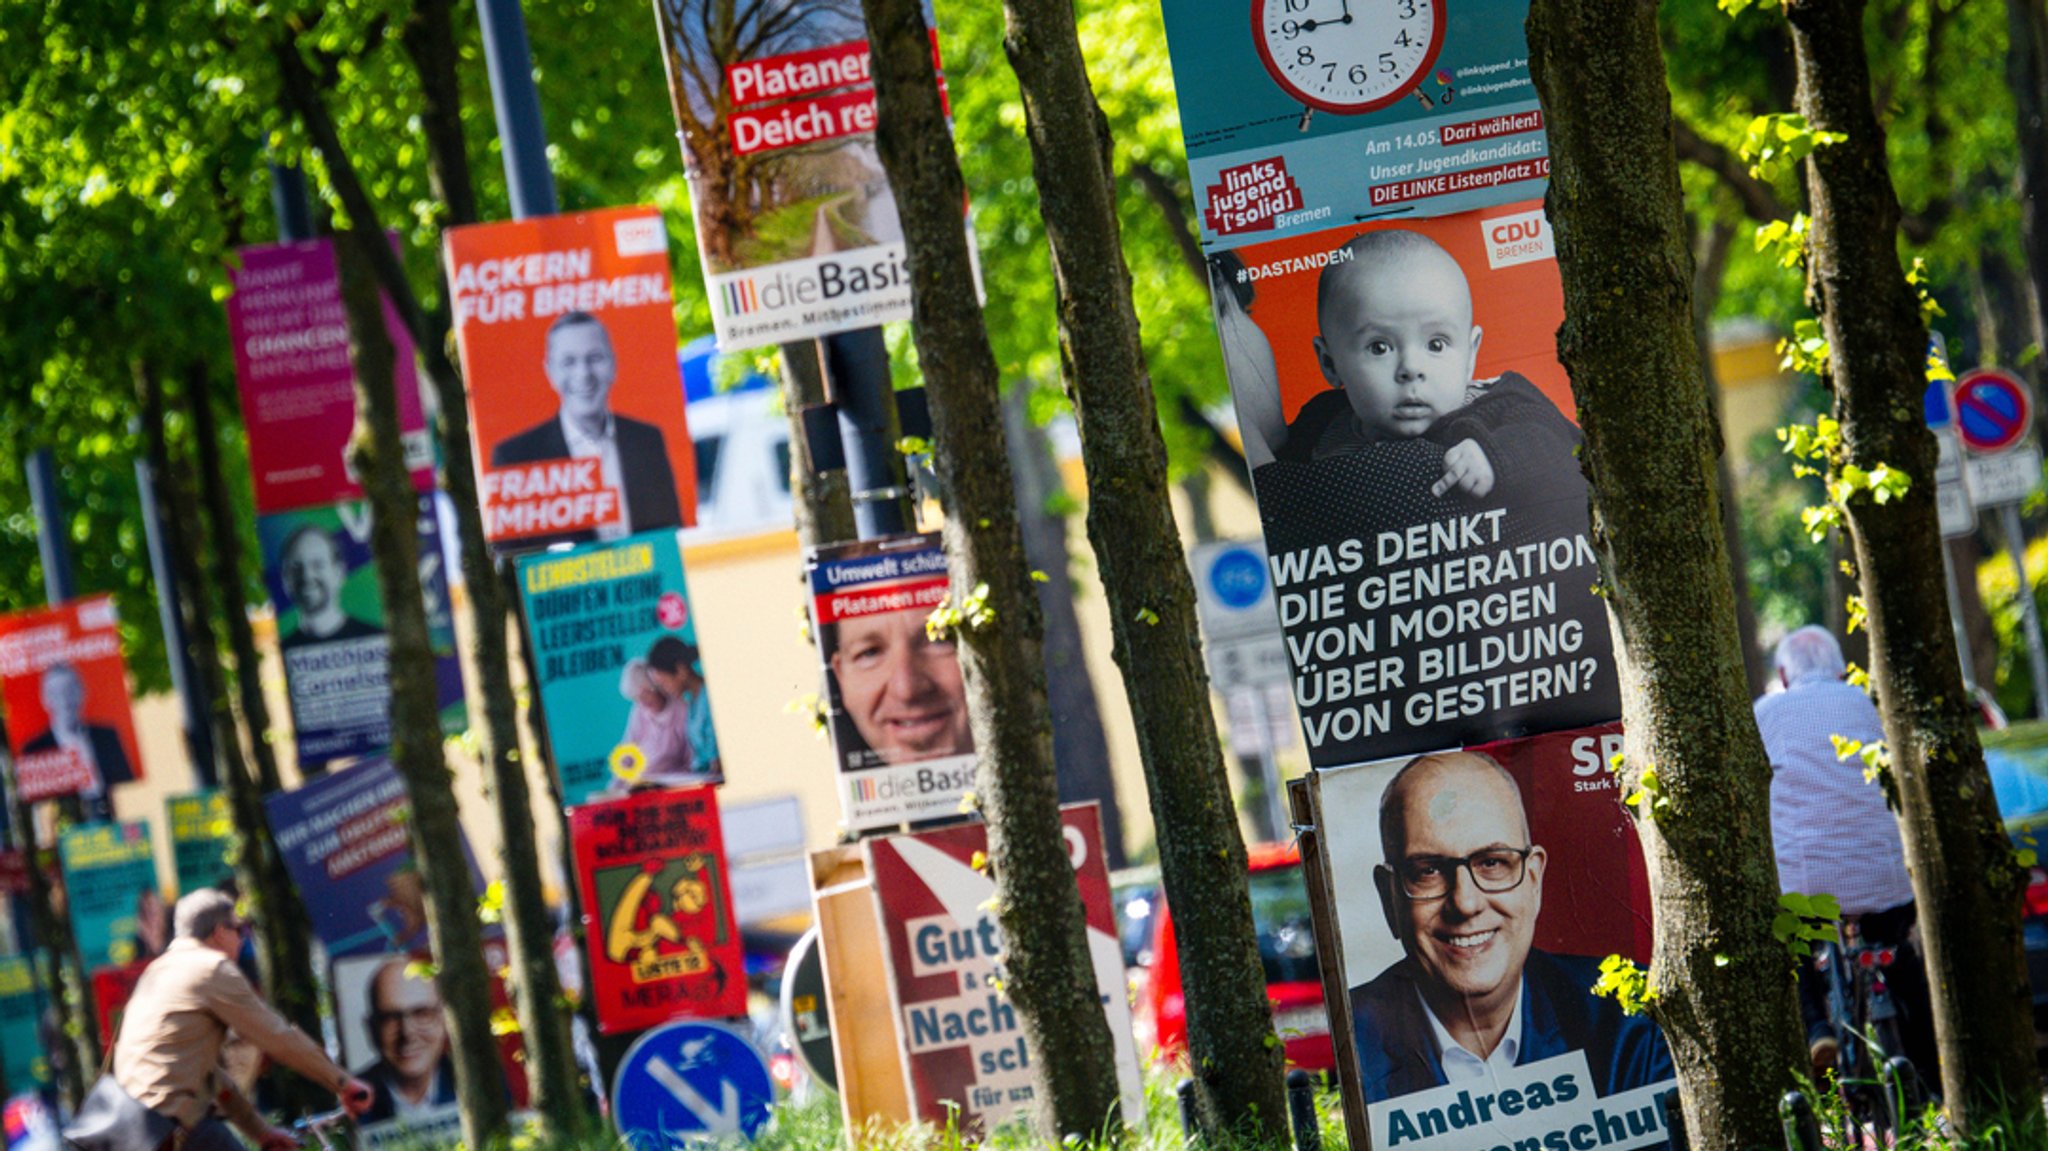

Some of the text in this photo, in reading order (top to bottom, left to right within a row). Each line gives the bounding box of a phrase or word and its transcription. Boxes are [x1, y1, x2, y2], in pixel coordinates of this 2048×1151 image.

[1281, 19, 1300, 40] 9
[1394, 29, 1412, 48] 4
[1297, 46, 1315, 66] 8
[1321, 63, 1337, 82] 7
[1348, 64, 1367, 85] 6
[1378, 52, 1396, 73] 5
[734, 103, 833, 152] Deich
[1366, 113, 1538, 156] Am 14.05. Dari wählen!
[1226, 163, 1276, 192] links
[1370, 140, 1542, 180] Unser Jugendkandidat:
[1212, 170, 1286, 219] jugend
[1374, 186, 1399, 203] DIE
[1403, 177, 1446, 198] LINKE
[1449, 164, 1530, 190] Listenplatz
[1275, 206, 1331, 229] Bremen
[1491, 219, 1541, 244] CDU
[1236, 247, 1354, 283] #DASTANDEM
[1496, 241, 1543, 260] BREMEN
[456, 249, 591, 292] ACKERN
[460, 274, 671, 324] FÜR BREMEN.
[484, 462, 596, 501] FRANK
[486, 493, 615, 534] IMHOFF
[1270, 508, 1507, 588] WAS DENKT
[826, 557, 899, 585] Umwelt
[1280, 534, 1597, 628] DIE GENERATION
[831, 592, 913, 617] Platanen
[1287, 582, 1556, 668] VON MORGEN
[1297, 620, 1584, 708] ÜBER BILDUNG
[1303, 657, 1598, 748] VON GESTERN?
[1574, 778, 1611, 792] Stark
[972, 1087, 1003, 1108] für
[1388, 1074, 1580, 1147] Andreas
